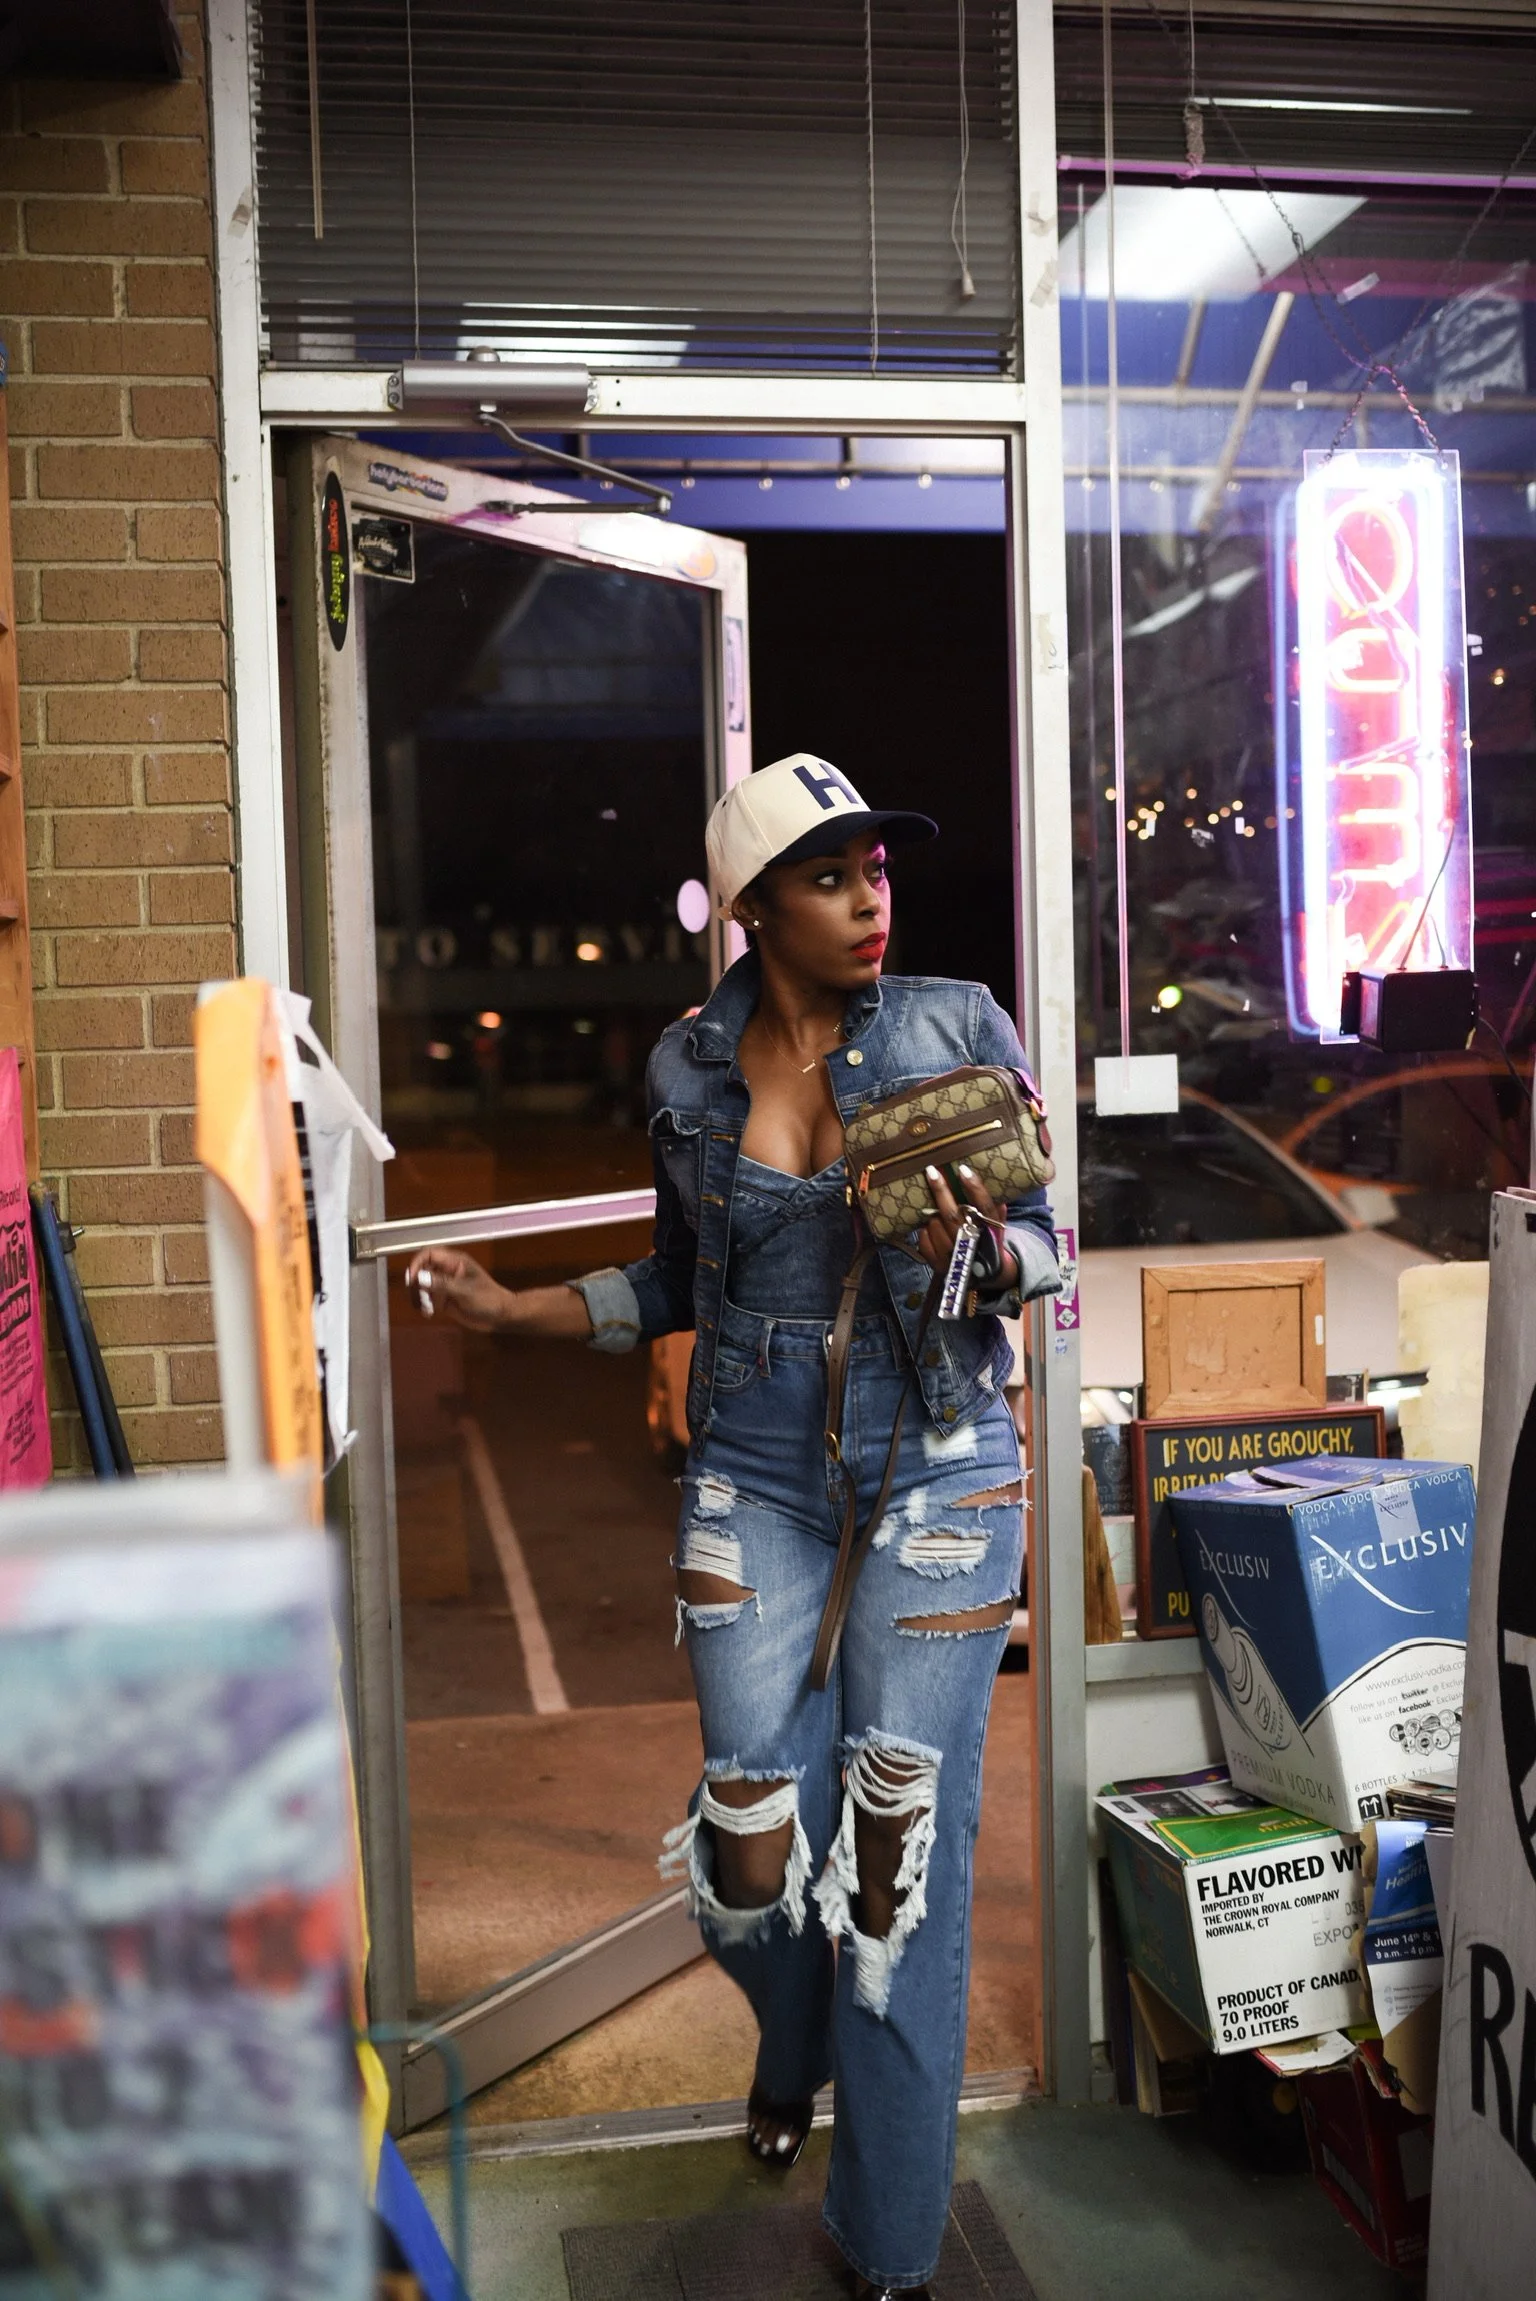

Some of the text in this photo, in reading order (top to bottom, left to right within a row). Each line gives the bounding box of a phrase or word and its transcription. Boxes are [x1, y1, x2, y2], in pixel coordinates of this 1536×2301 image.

[792, 762, 859, 811] H
[1163, 1427, 1354, 1467] IF YOU ARE GROUCHY,
[1299, 1501, 1335, 1516] VODCA
[1342, 1490, 1377, 1505] VODCA
[1427, 1472, 1462, 1487] VODCA
[1199, 1550, 1270, 1581] EXCLUSIV
[1313, 1522, 1467, 1581] EXCLUSIV
[1351, 1701, 1374, 1713] follow
[1388, 1695, 1398, 1703] on
[1401, 1687, 1429, 1700] twitter
[1374, 1712, 1383, 1720] us
[1385, 1709, 1395, 1718] on
[1231, 1750, 1284, 1786] PREMIUM
[1287, 1772, 1336, 1806] VODKA
[1362, 1775, 1398, 1791] BOTTLES
[1197, 1855, 1324, 1901] FLAVORED
[1201, 1892, 1265, 1914] IMPORTED BY
[1203, 1889, 1340, 1927] THE CROWN ROYAL COMPANY
[1205, 1917, 1270, 1939] NORWALK, CT
[1374, 1936, 1400, 1948] June
[1402, 1932, 1419, 1944] 14th
[1422, 1931, 1431, 1941] &
[1375, 1950, 1382, 1960] 9
[1384, 1948, 1402, 1959] a.m.
[1410, 1946, 1416, 1955] 4
[1217, 1969, 1361, 2011] PRODUCT OF CANAD
[1220, 2000, 1290, 2027] 70 PROOF
[1223, 2015, 1299, 2043] 9.0 LITERS
